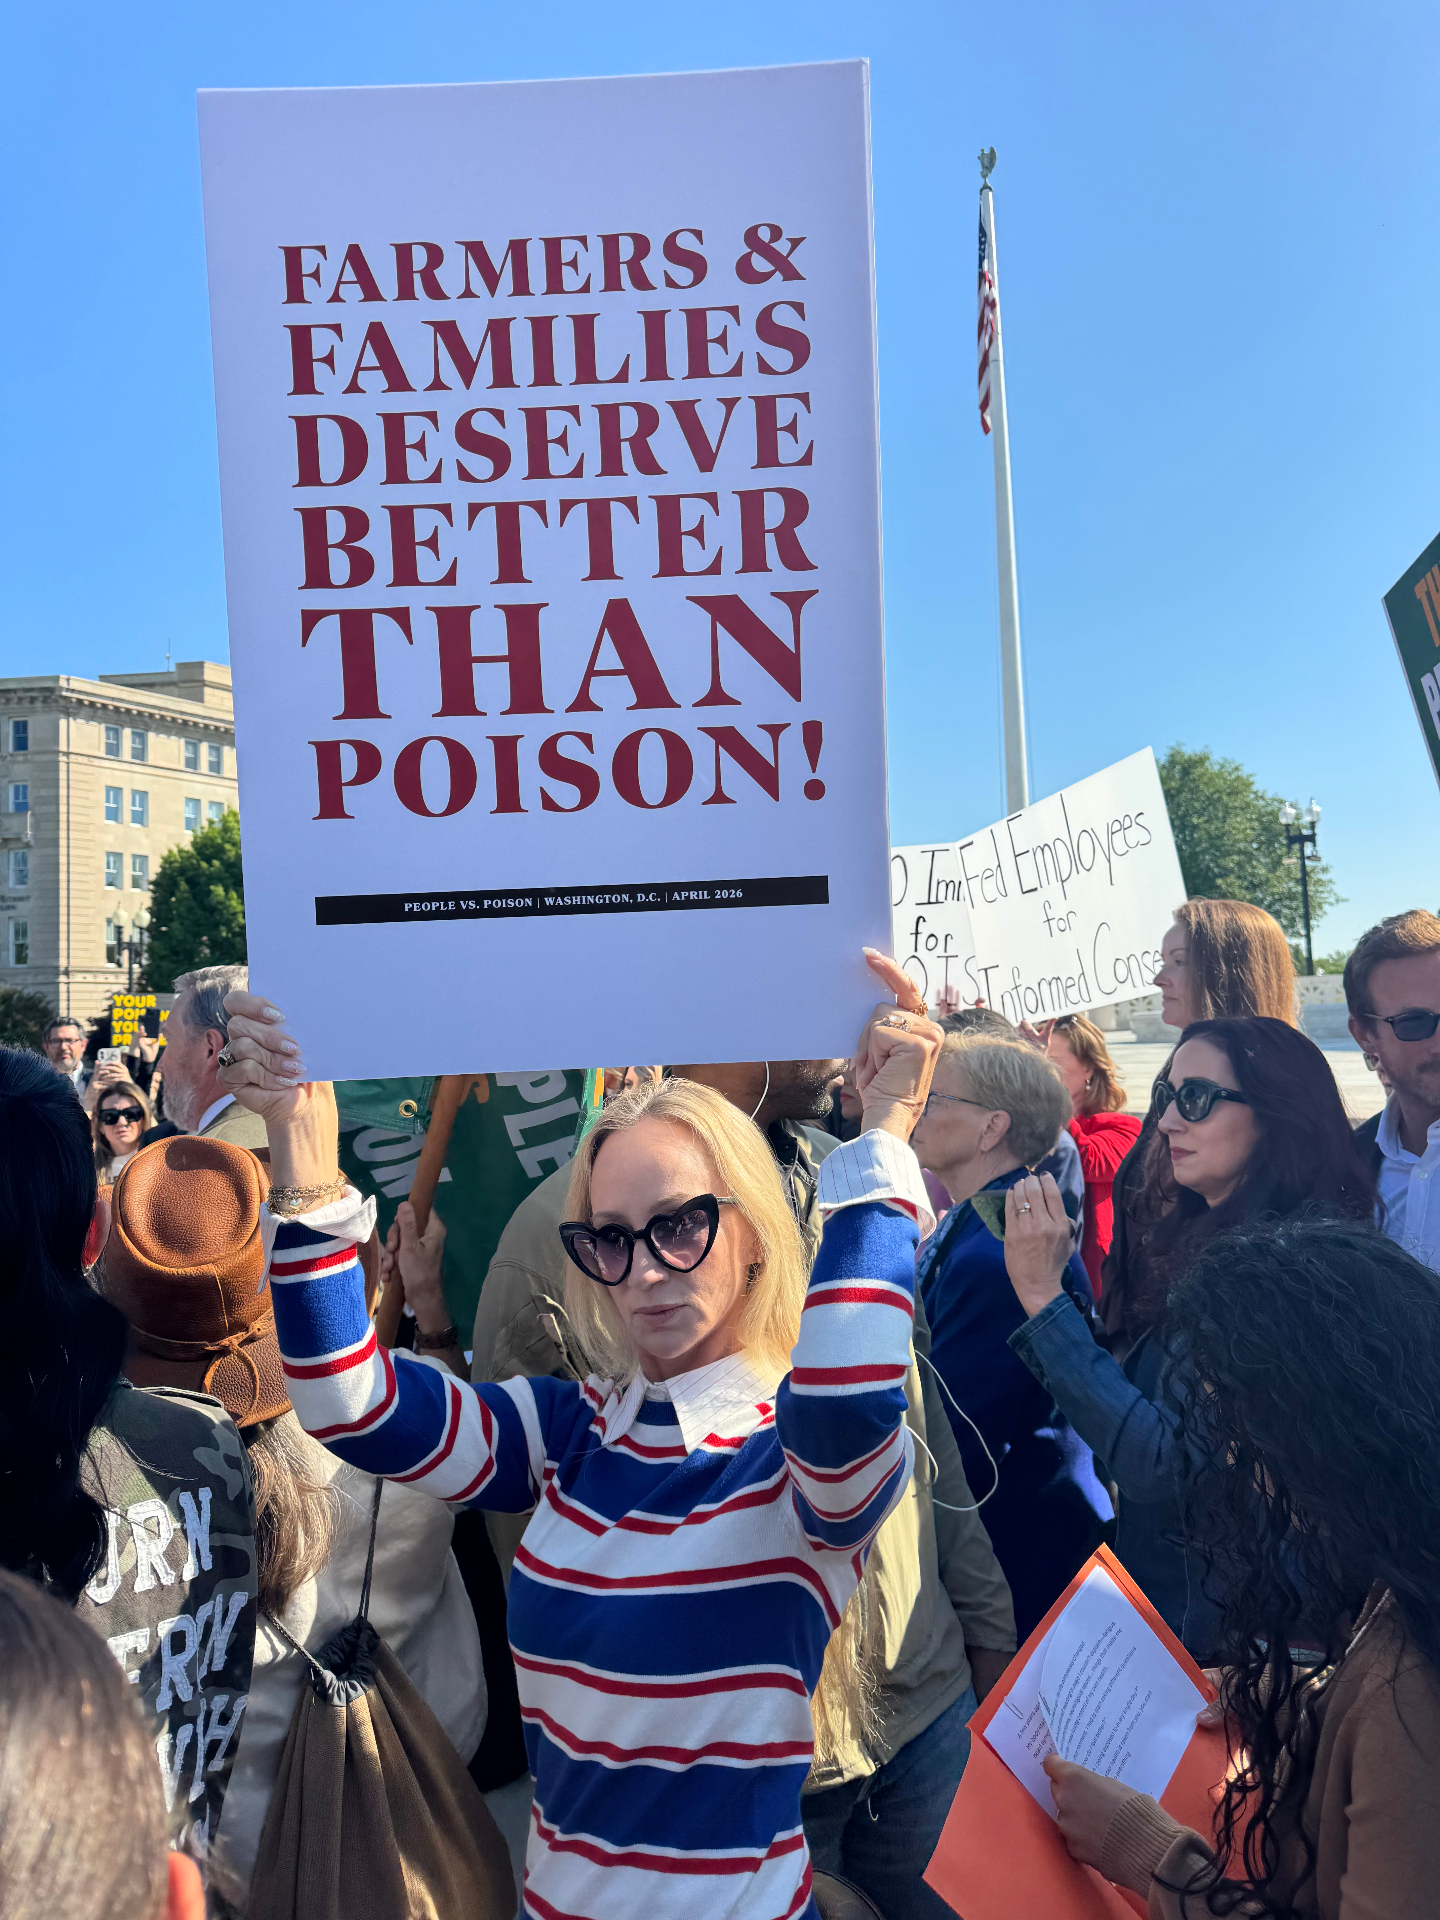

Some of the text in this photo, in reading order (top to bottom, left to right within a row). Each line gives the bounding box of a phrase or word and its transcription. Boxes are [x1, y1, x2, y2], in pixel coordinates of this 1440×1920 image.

[278, 223, 806, 304] FARMERS &
[282, 300, 811, 396] FAMILIES
[288, 391, 814, 488] DESERVE
[293, 486, 819, 590] BETTER
[301, 589, 819, 720] THAN
[307, 720, 827, 821] POISON!
[958, 829, 1008, 909] Fed
[1007, 793, 1152, 900] Employees
[404, 888, 743, 912] PEOPLE VS. POISON WASHINGTON, D.C. APRIL 2026
[910, 915, 954, 953] for
[1042, 900, 1077, 937] for
[112, 994, 157, 1008] YOUR
[976, 948, 1092, 1024] Informed
